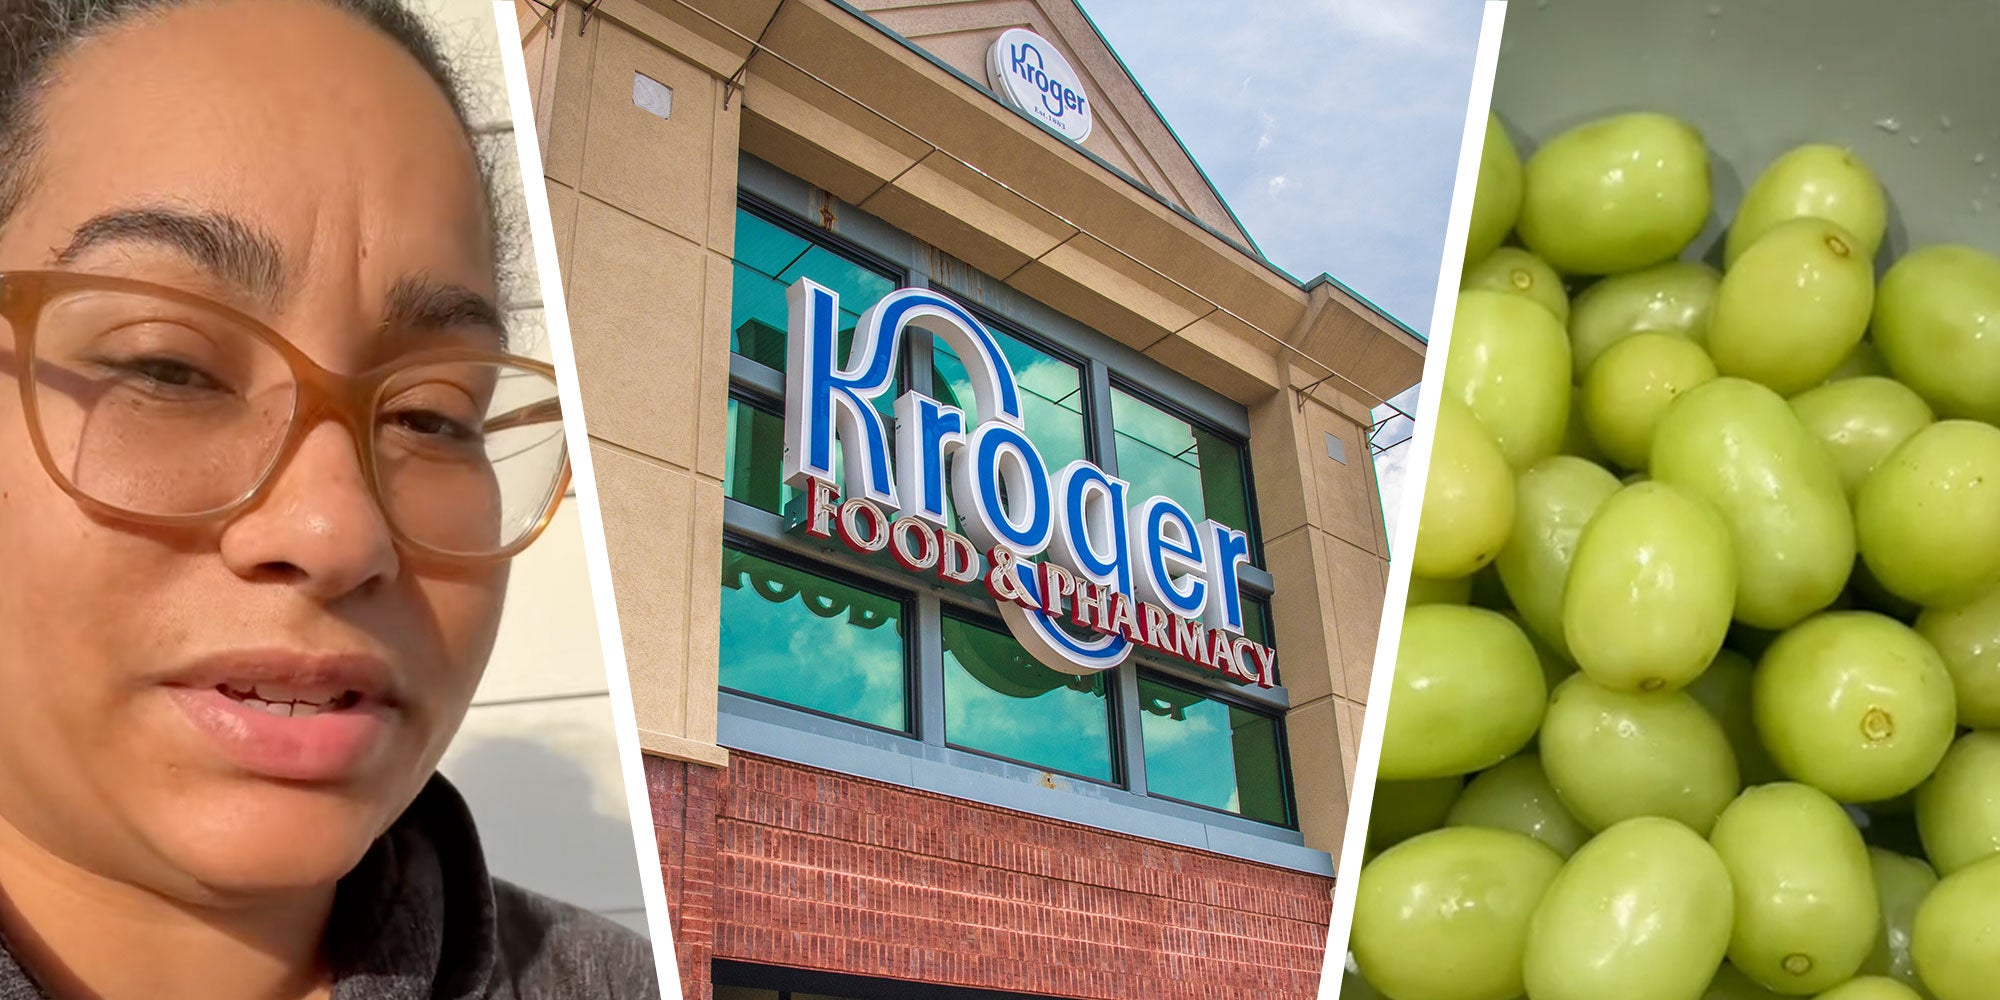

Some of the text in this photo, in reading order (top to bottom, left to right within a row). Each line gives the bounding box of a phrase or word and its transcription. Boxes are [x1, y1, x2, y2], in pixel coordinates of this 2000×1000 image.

[1010, 43, 1085, 117] Kroger
[786, 277, 1250, 674] Kroger
[806, 476, 980, 585] FOOD
[984, 544, 1042, 610] &
[1039, 561, 1275, 689] PHARMACY
